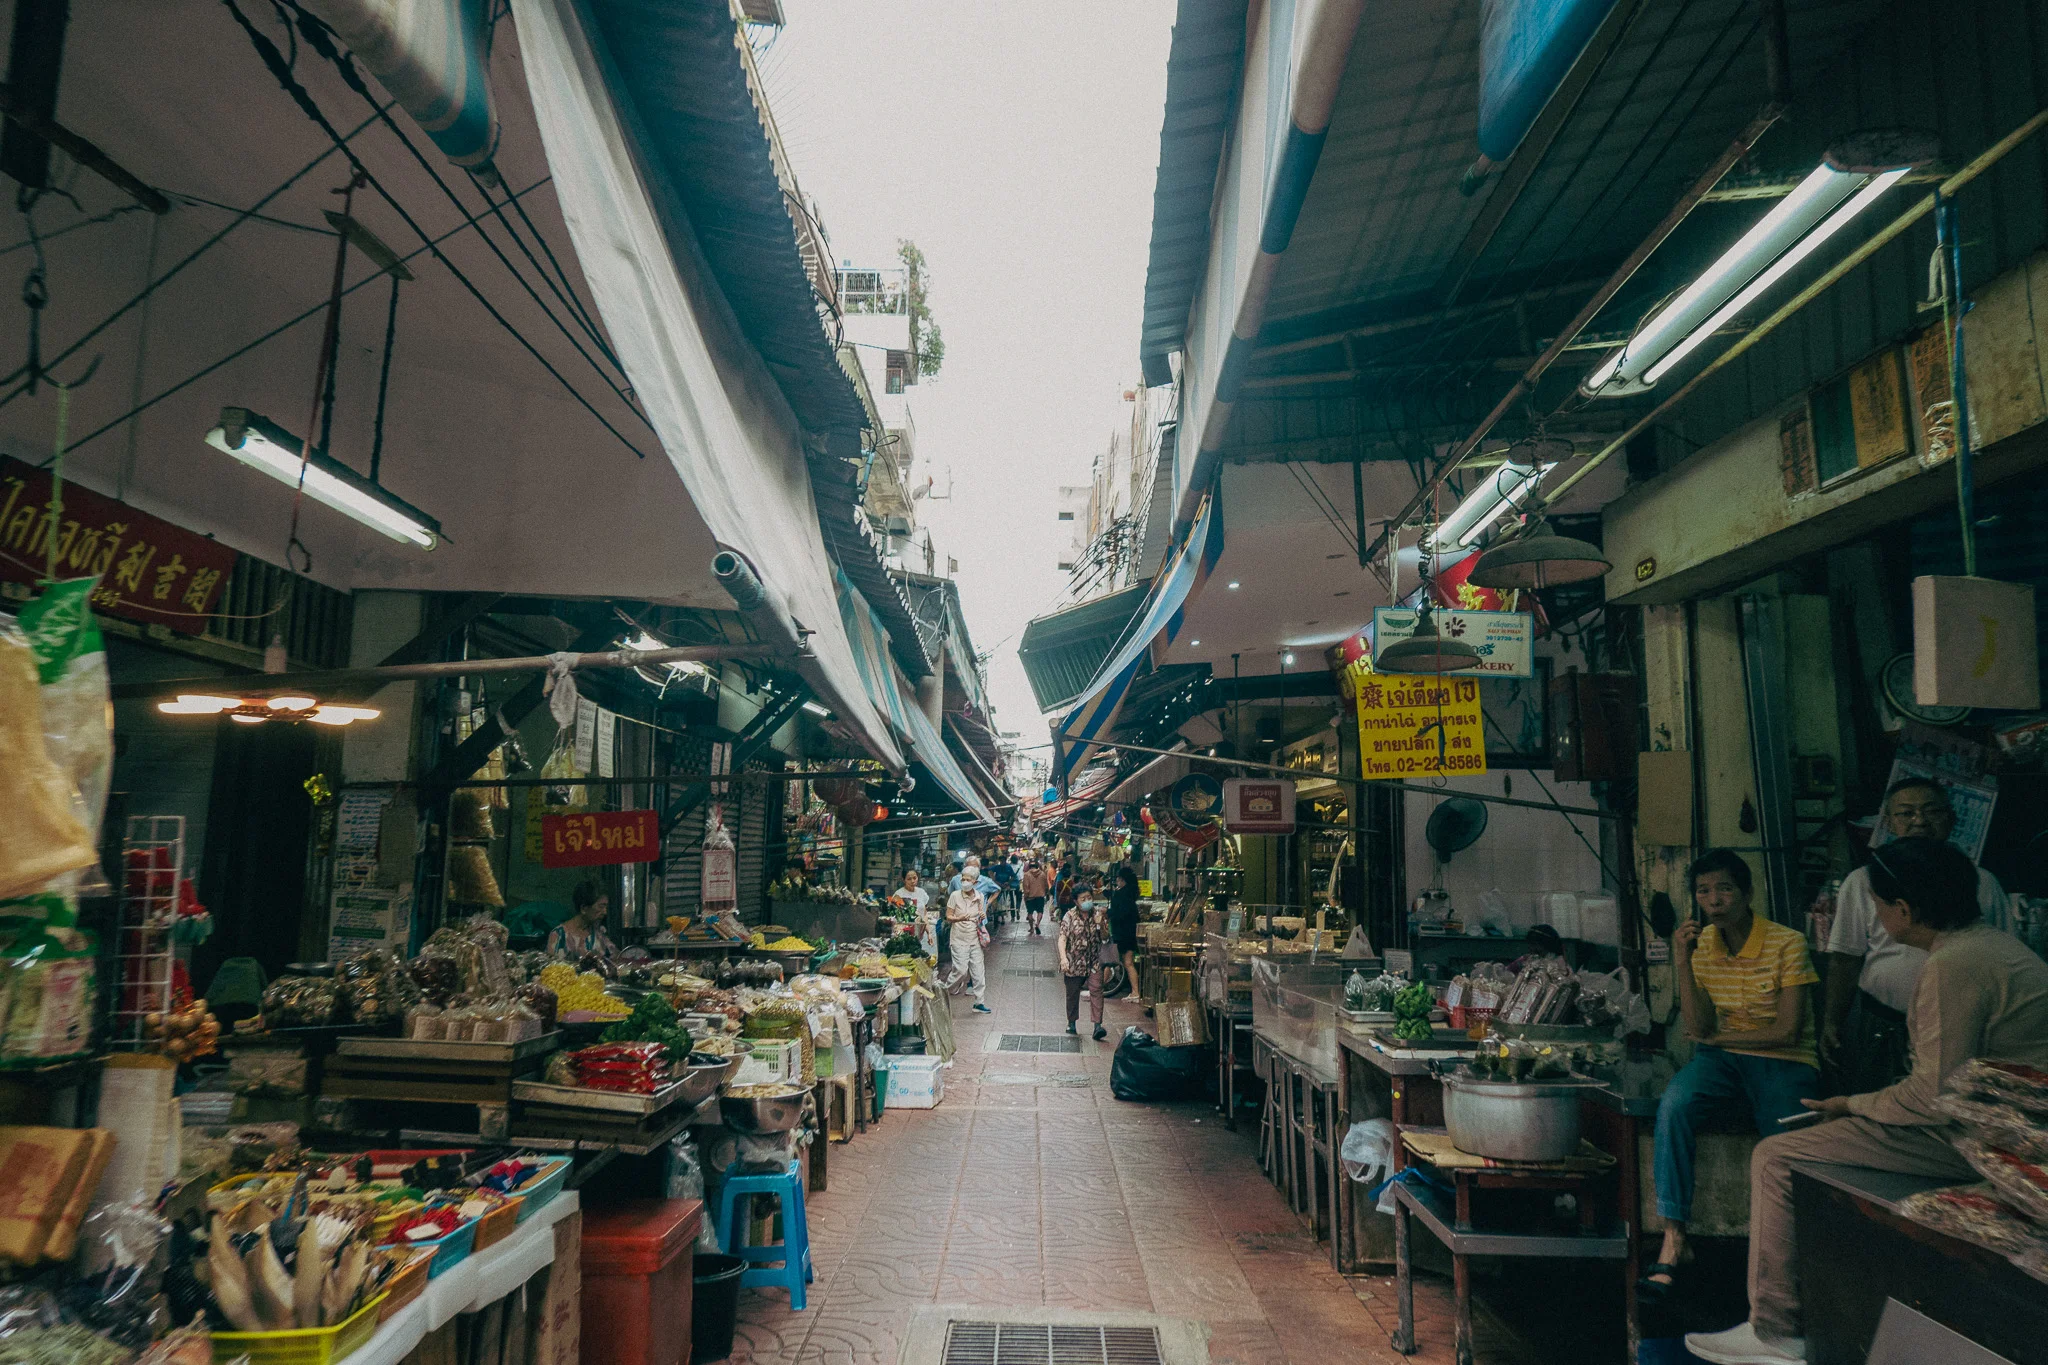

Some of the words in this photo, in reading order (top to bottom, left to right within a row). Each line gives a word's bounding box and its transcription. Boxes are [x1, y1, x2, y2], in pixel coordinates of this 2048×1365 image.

[1451, 730, 1472, 749] ส่ง
[555, 816, 645, 853] เจ๊ใหม่
